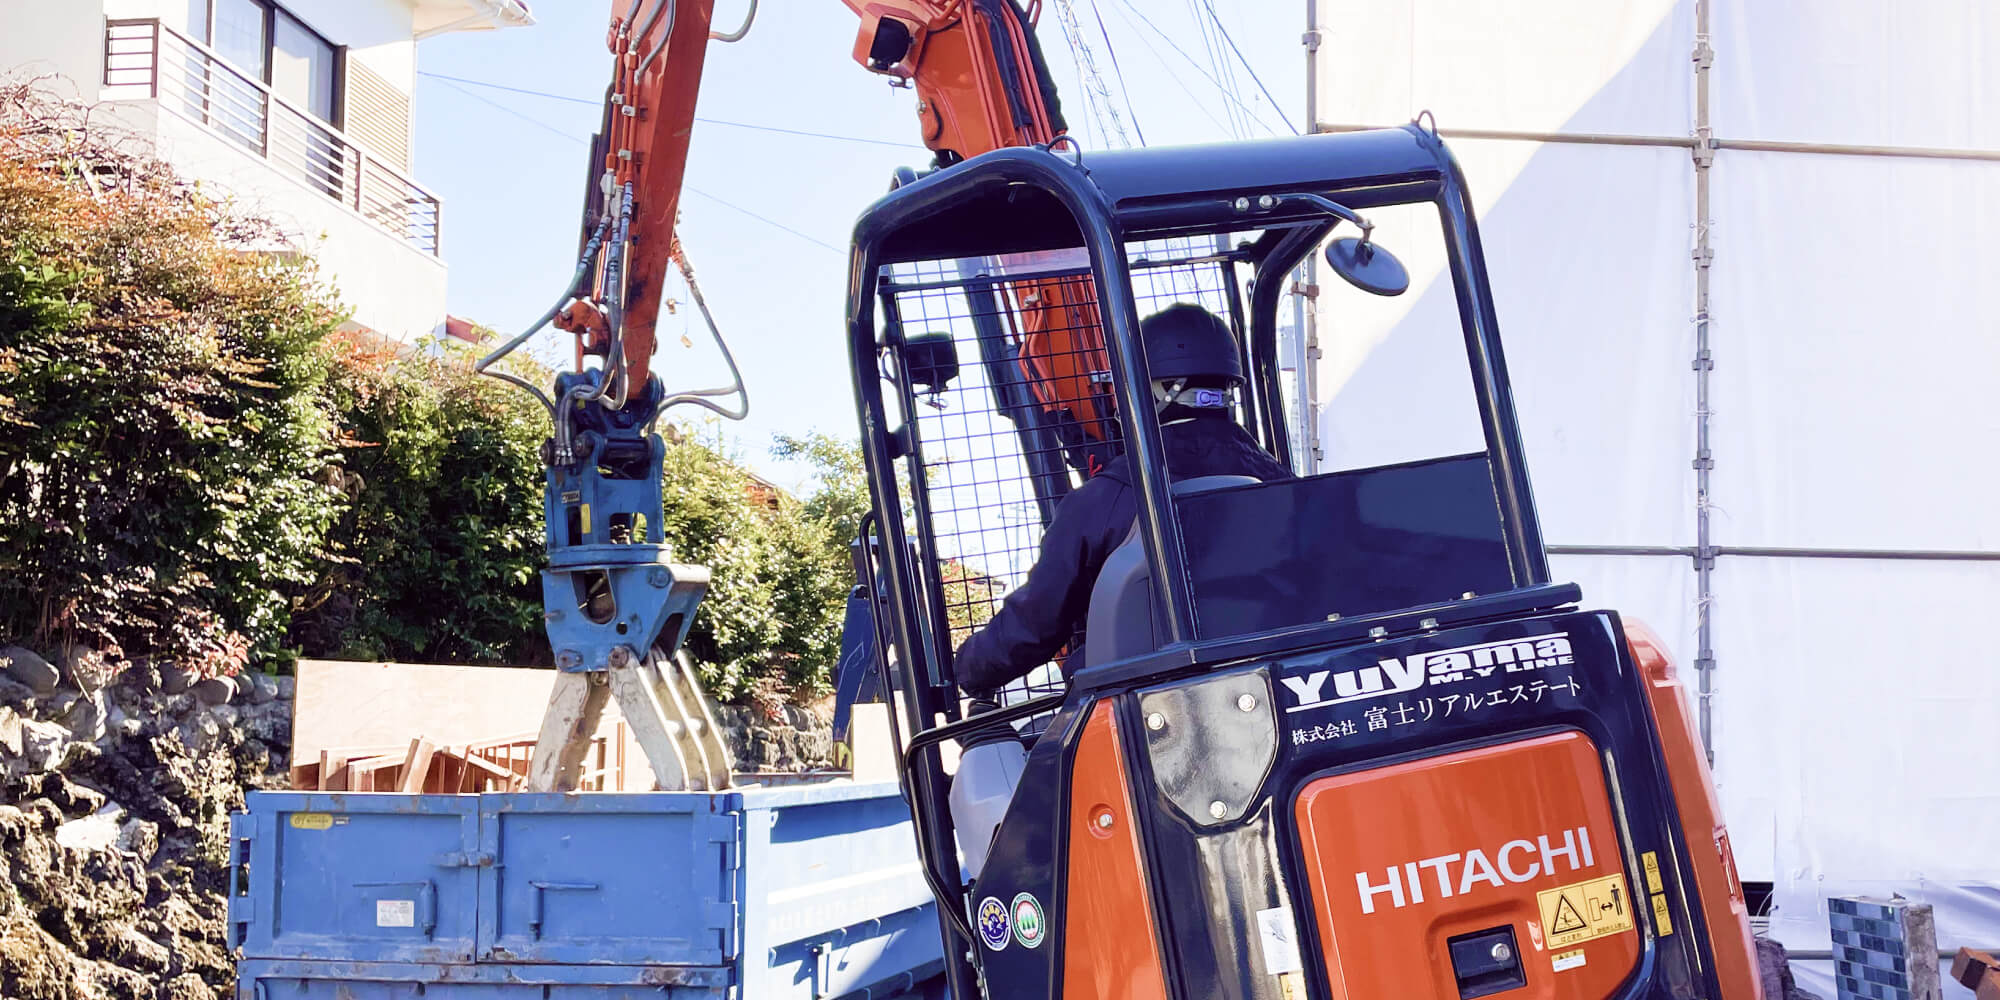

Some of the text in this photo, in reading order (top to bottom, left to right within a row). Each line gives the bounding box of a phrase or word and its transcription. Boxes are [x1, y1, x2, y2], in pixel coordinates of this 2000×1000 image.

[1506, 655, 1575, 673] LINE
[1292, 675, 1582, 746] 株式会社 富士リアルエステート
[1355, 827, 1596, 914] HITACHI
